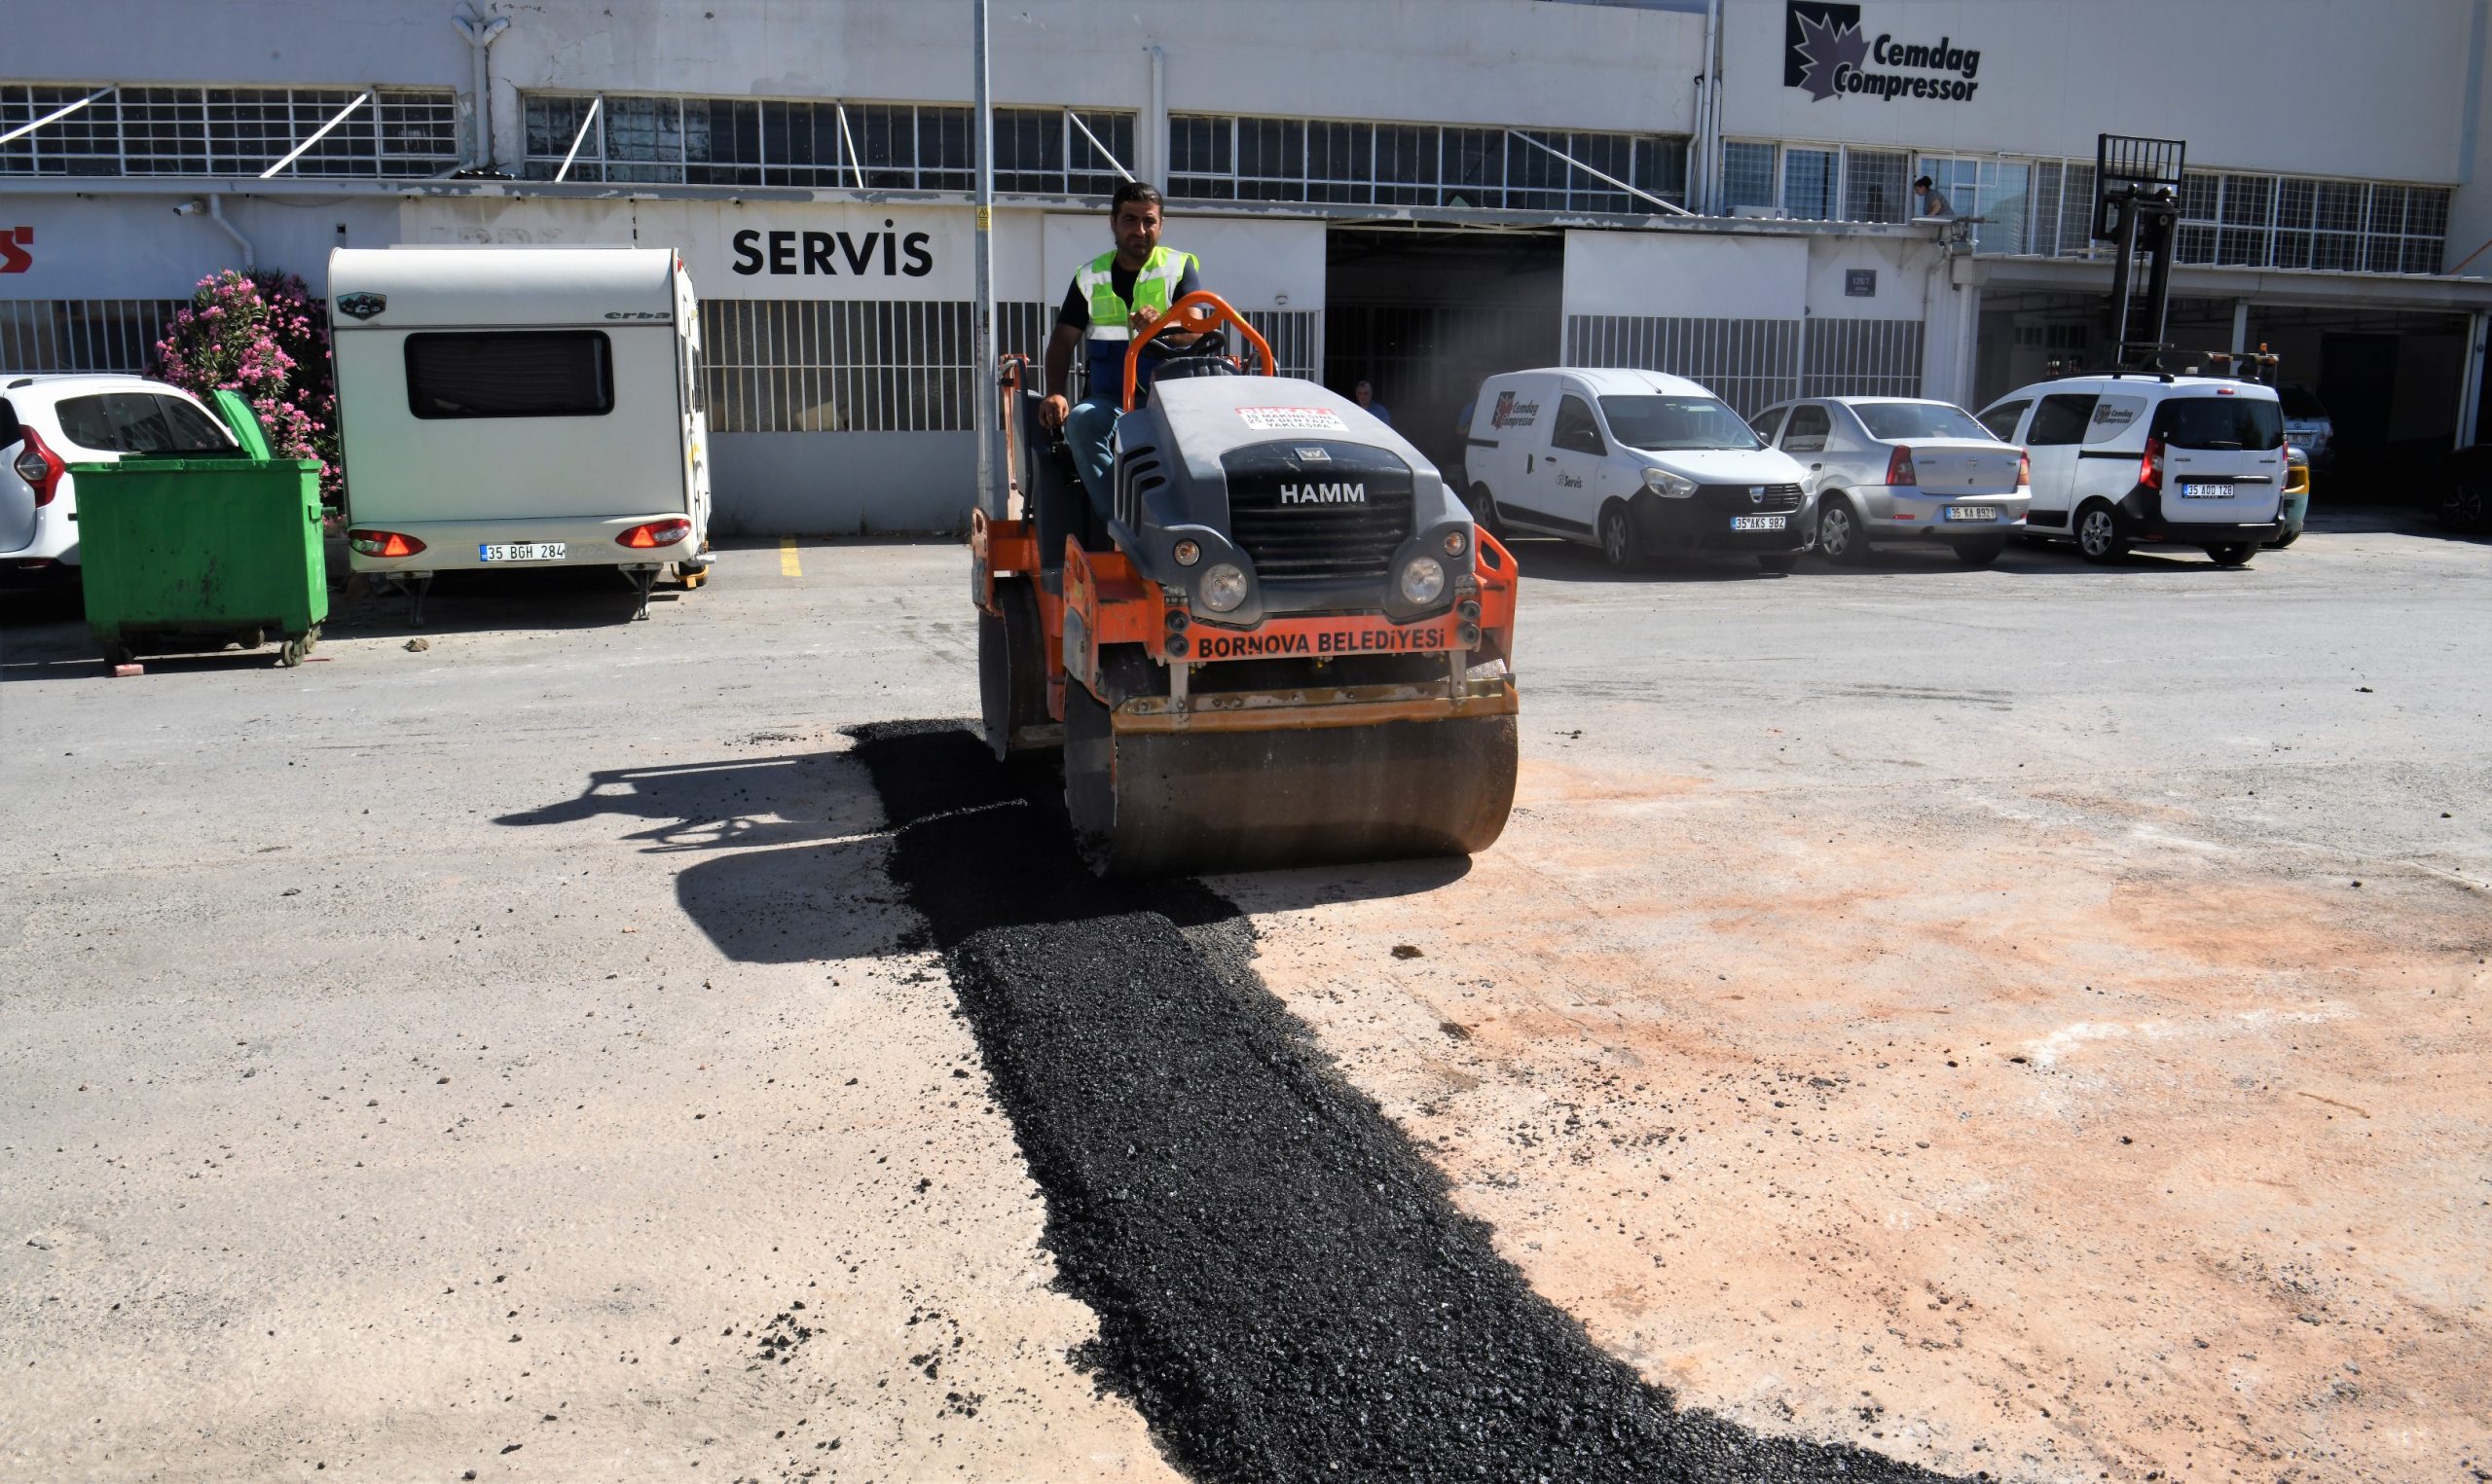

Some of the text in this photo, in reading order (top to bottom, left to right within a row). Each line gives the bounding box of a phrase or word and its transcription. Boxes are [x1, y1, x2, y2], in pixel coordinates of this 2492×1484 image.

[1874, 34, 1980, 78] Cemdag
[1833, 63, 1978, 101] Compressor
[1513, 400, 1540, 416] Cemdag
[1280, 483, 1365, 504] HAMM
[2188, 486, 2198, 495] 35
[2218, 485, 2232, 495] 128
[1951, 508, 1995, 518] 35 KA 8921
[1736, 517, 1784, 528] 35 AKS 982
[488, 545, 564, 560] 35 BGH 284
[1198, 634, 1310, 658] BORNOVA
